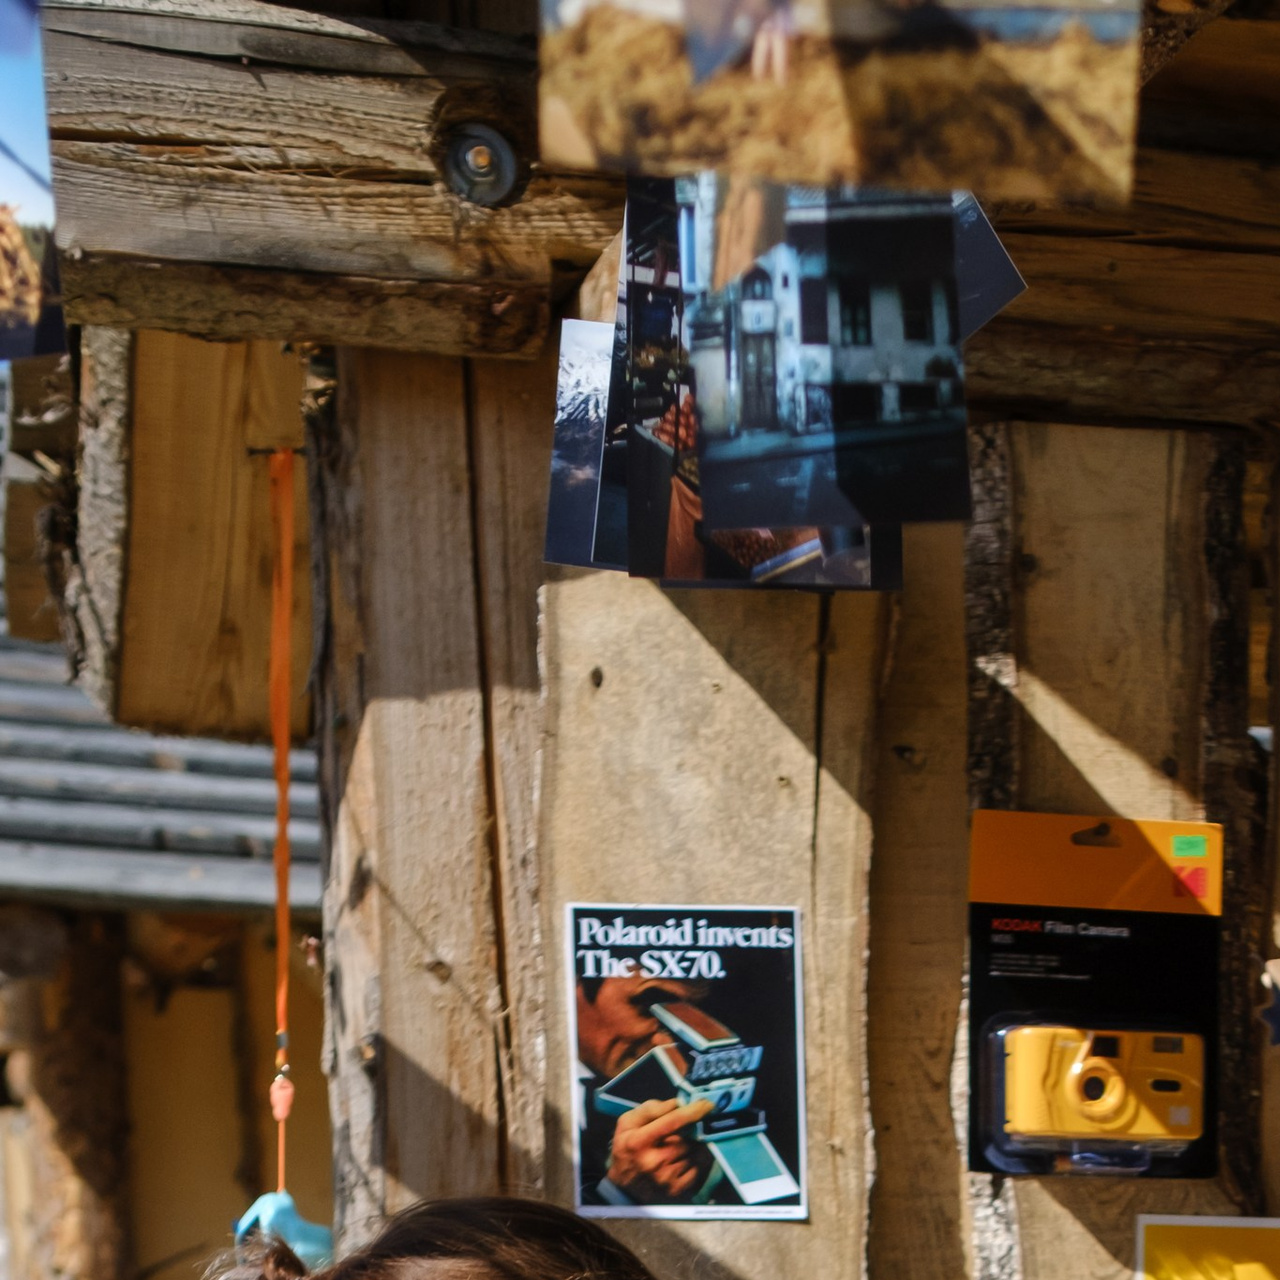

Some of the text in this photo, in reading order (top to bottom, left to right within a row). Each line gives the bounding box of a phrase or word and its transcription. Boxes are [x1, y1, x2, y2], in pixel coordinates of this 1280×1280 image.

[577, 916, 794, 949] Polaroid invents
[991, 918, 1130, 937] KODAK Film Camera
[577, 949, 726, 979] The SX-70.
